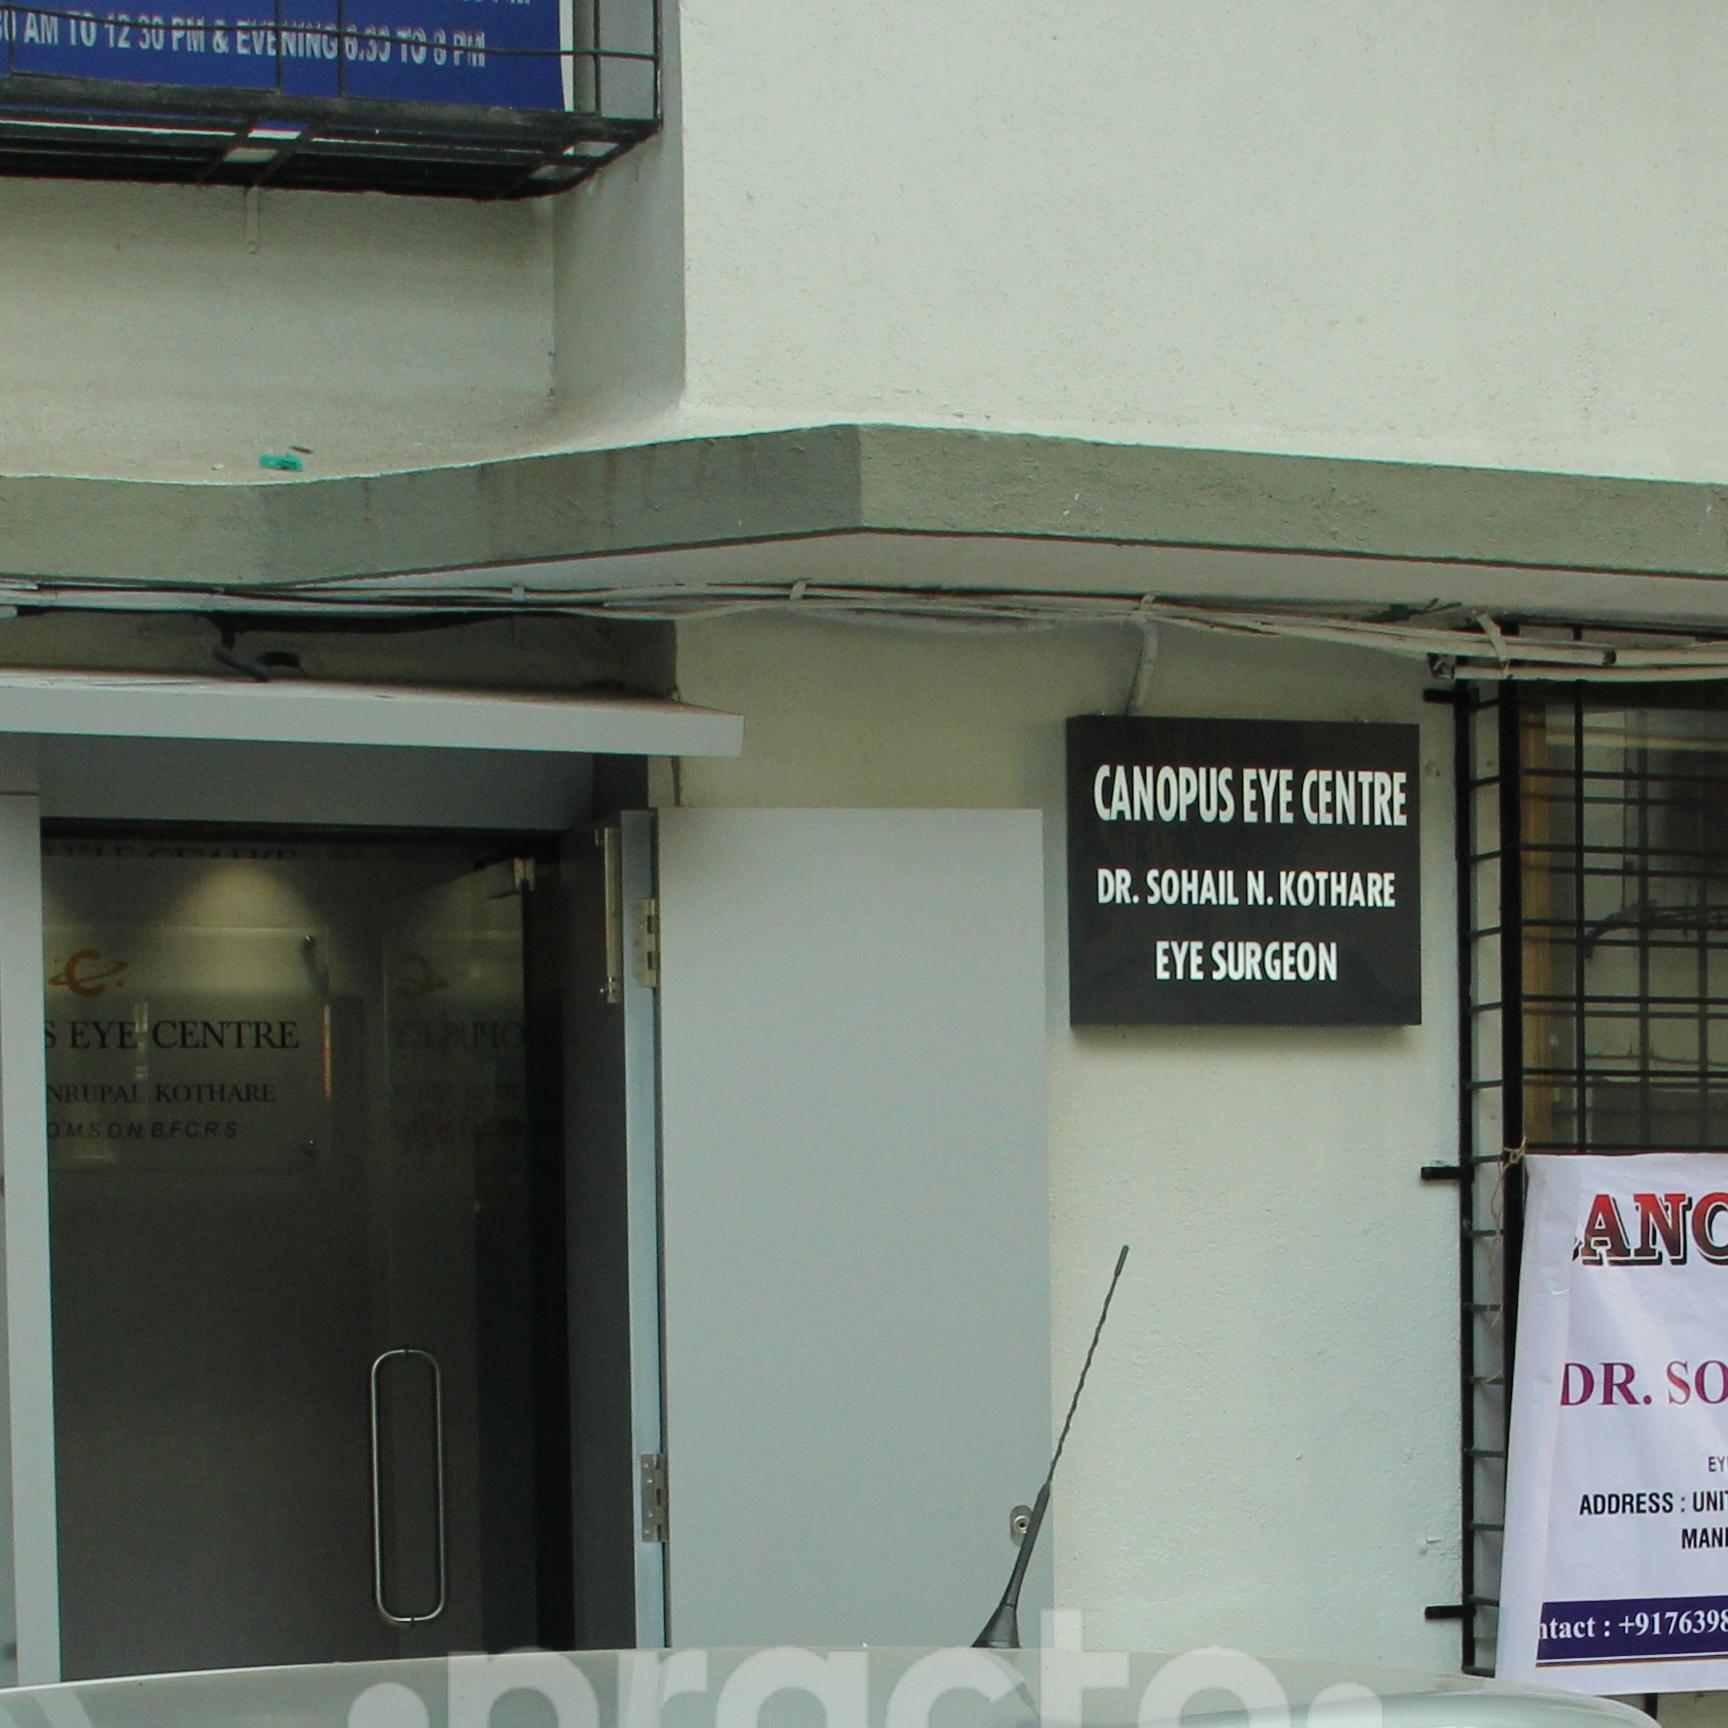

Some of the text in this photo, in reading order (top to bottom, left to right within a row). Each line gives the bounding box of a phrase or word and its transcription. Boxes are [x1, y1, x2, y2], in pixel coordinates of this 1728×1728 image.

[23, 12, 59, 45] AM
[67, 11, 98, 48] TO
[172, 17, 205, 53] PM
[211, 19, 230, 53] &
[236, 19, 338, 60] EVENING
[396, 26, 427, 65] TO
[453, 30, 486, 68] PM
[1093, 764, 1408, 826] CANOPUS EYE CENTRE
[1097, 868, 1396, 907] DR. SOHAIL N. KOTHARE
[1155, 940, 1338, 981] EYE SURGEON
[69, 1020, 138, 1049] EYE
[152, 1020, 300, 1049] CENTRE
[155, 1084, 277, 1104] KOTHARE
[1559, 1361, 1653, 1407] DR.
[1578, 1492, 1674, 1516] ADDRESS
